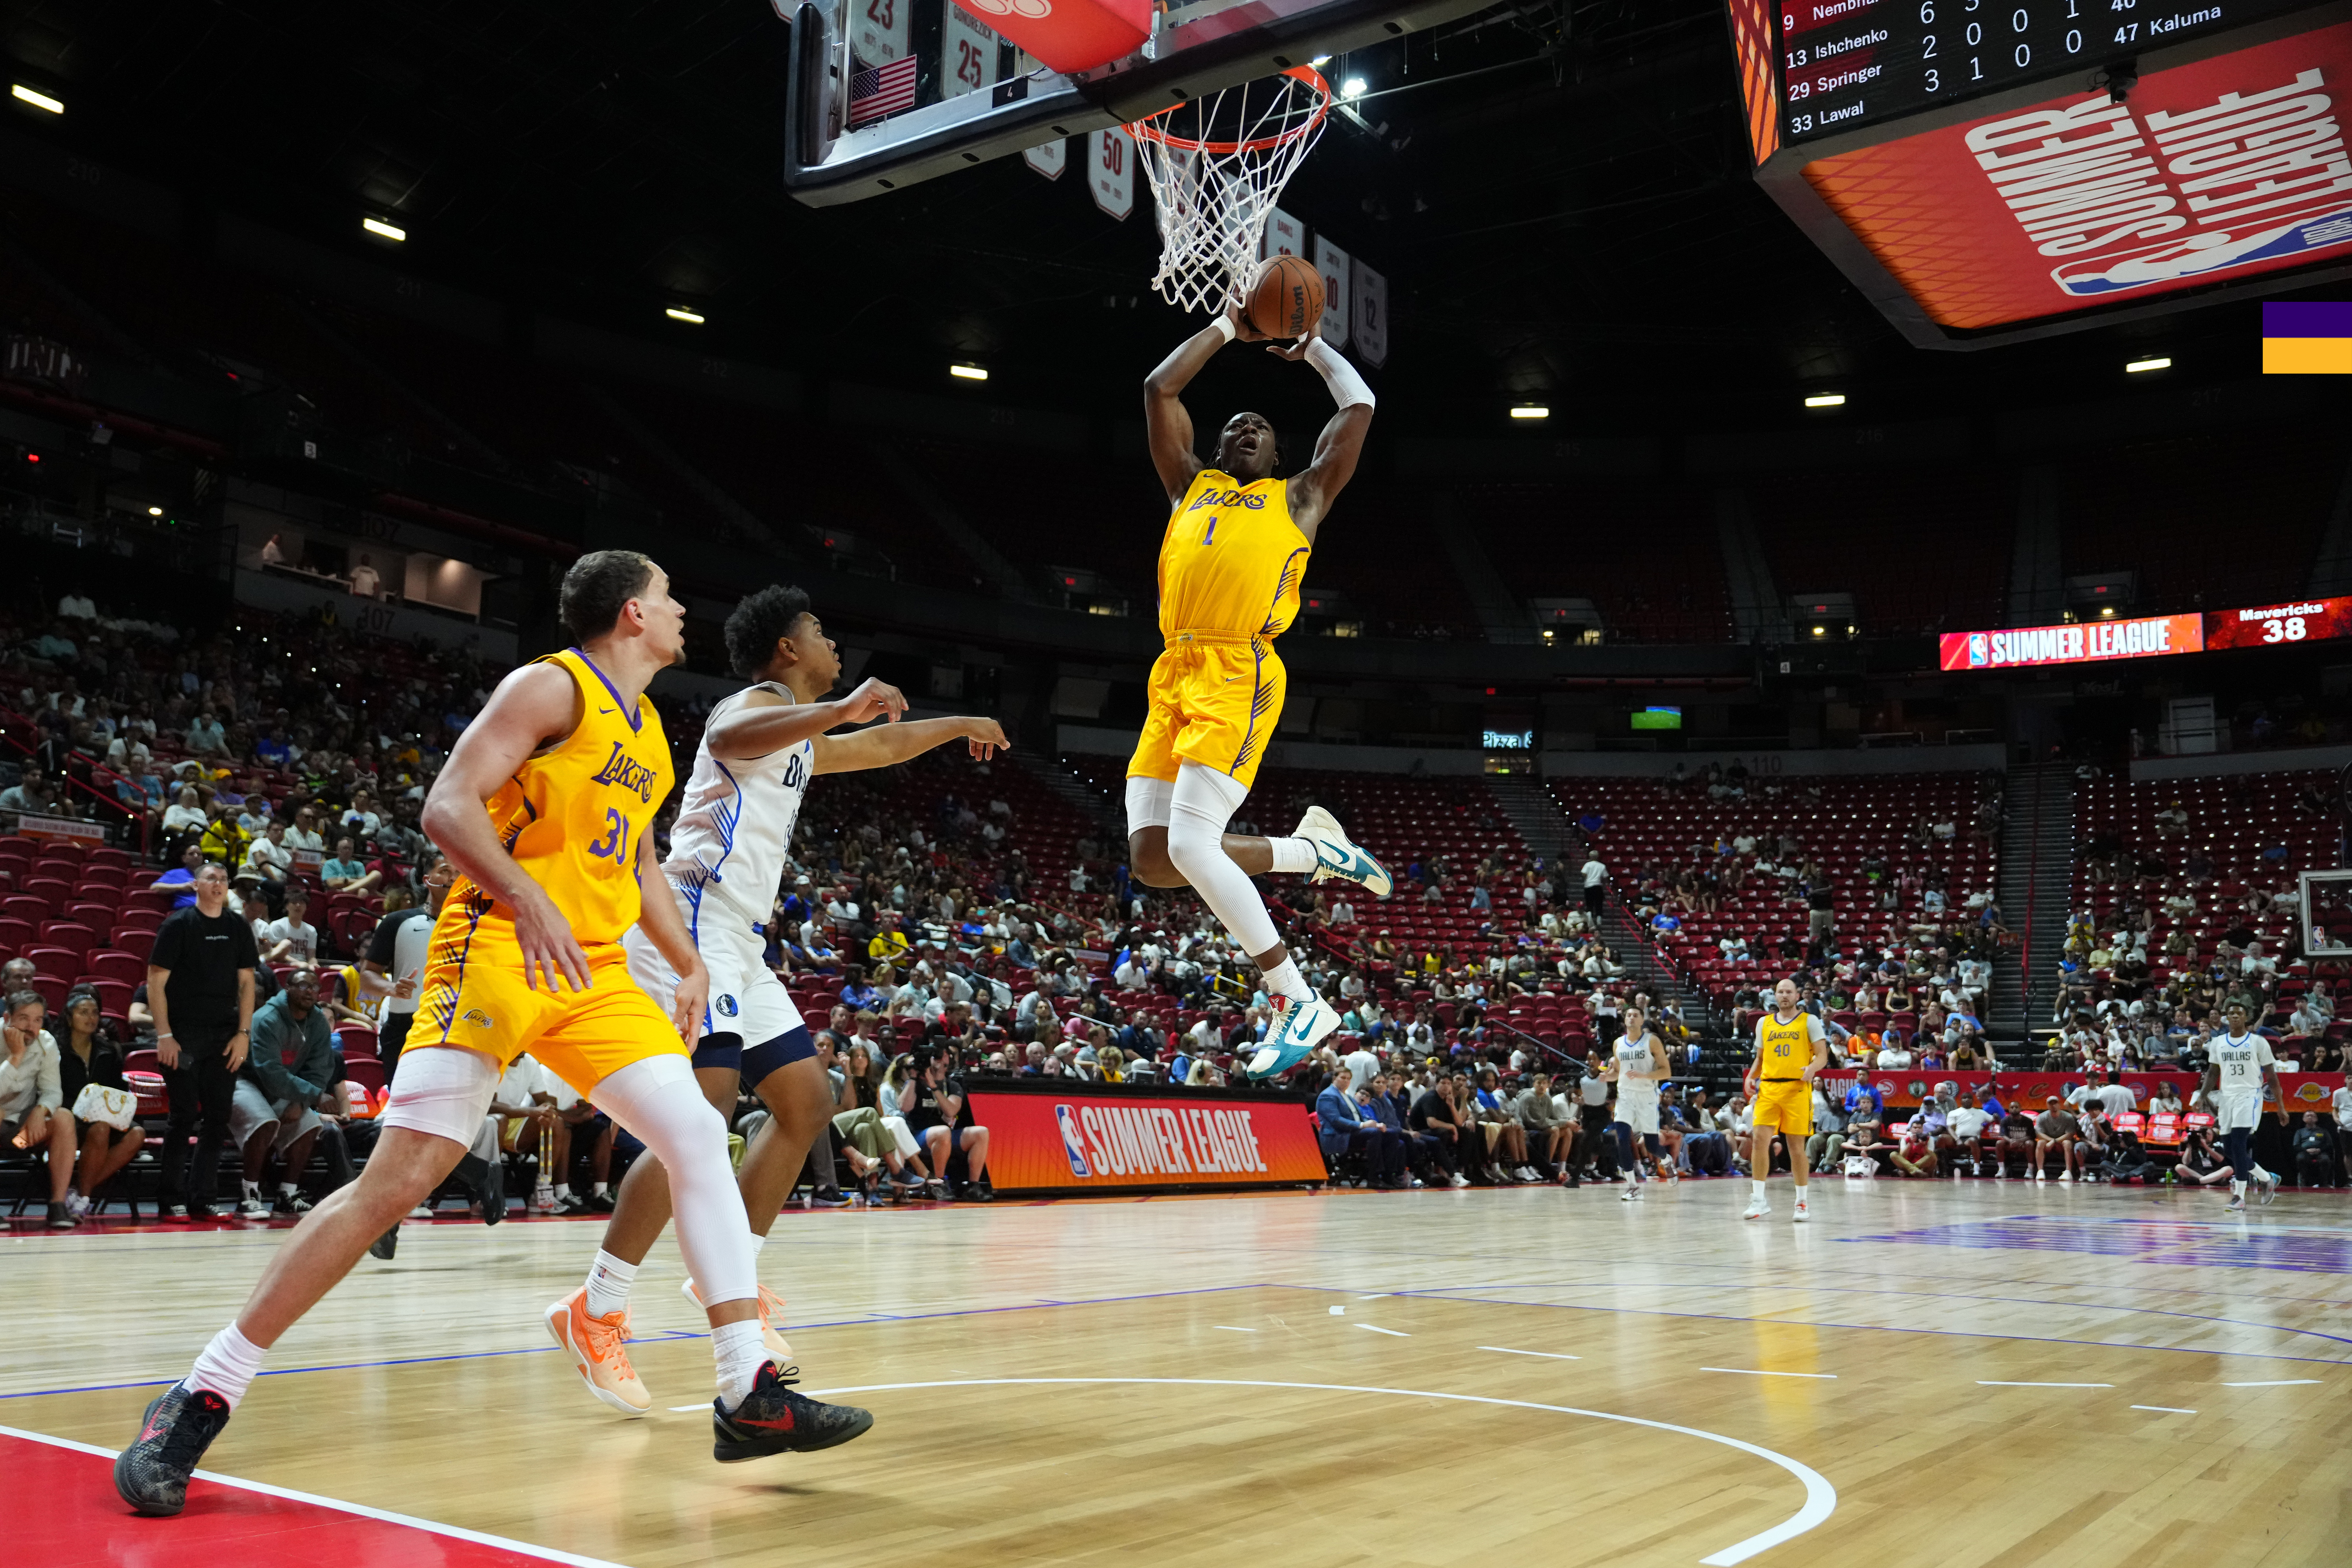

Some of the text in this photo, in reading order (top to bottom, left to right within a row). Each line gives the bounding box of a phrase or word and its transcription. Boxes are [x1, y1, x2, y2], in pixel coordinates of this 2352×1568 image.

[1784, 14, 1794, 31] 9
[1786, 1, 1935, 69] 13 Ishchenko 6
[957, 39, 982, 89] 25
[1789, 82, 1810, 102] 29
[1817, 64, 1882, 92] Springer
[1922, 35, 1937, 59] 2
[1966, 23, 1982, 46] 0
[2013, 9, 2028, 32] 0
[1791, 6, 2222, 134] 33 Lawal 3 1 0 0 47 Kaluma
[1103, 130, 1122, 176] 50
[2144, 67, 2352, 225] LEAGUE
[1964, 93, 2187, 257] SUMMER
[1289, 285, 1305, 336] Wilson
[1326, 275, 1339, 311] 10
[1187, 488, 1268, 513] LAKERS
[1202, 516, 1218, 546] 1
[2239, 602, 2323, 622] Mavericks
[2262, 617, 2306, 643] 38
[1991, 619, 2171, 664] SUMMER LEAGUE
[1483, 732, 1519, 749] Pizza
[590, 740, 657, 804] LAKERS
[1766, 1030, 1800, 1042] LAKERS
[1774, 1043, 1791, 1057] 40
[1619, 1049, 1645, 1062] DALLAS
[2221, 1051, 2251, 1062] DALLAS
[2230, 1064, 2244, 1076] 33
[1081, 1106, 1268, 1176] SUMMER LEAGUE
